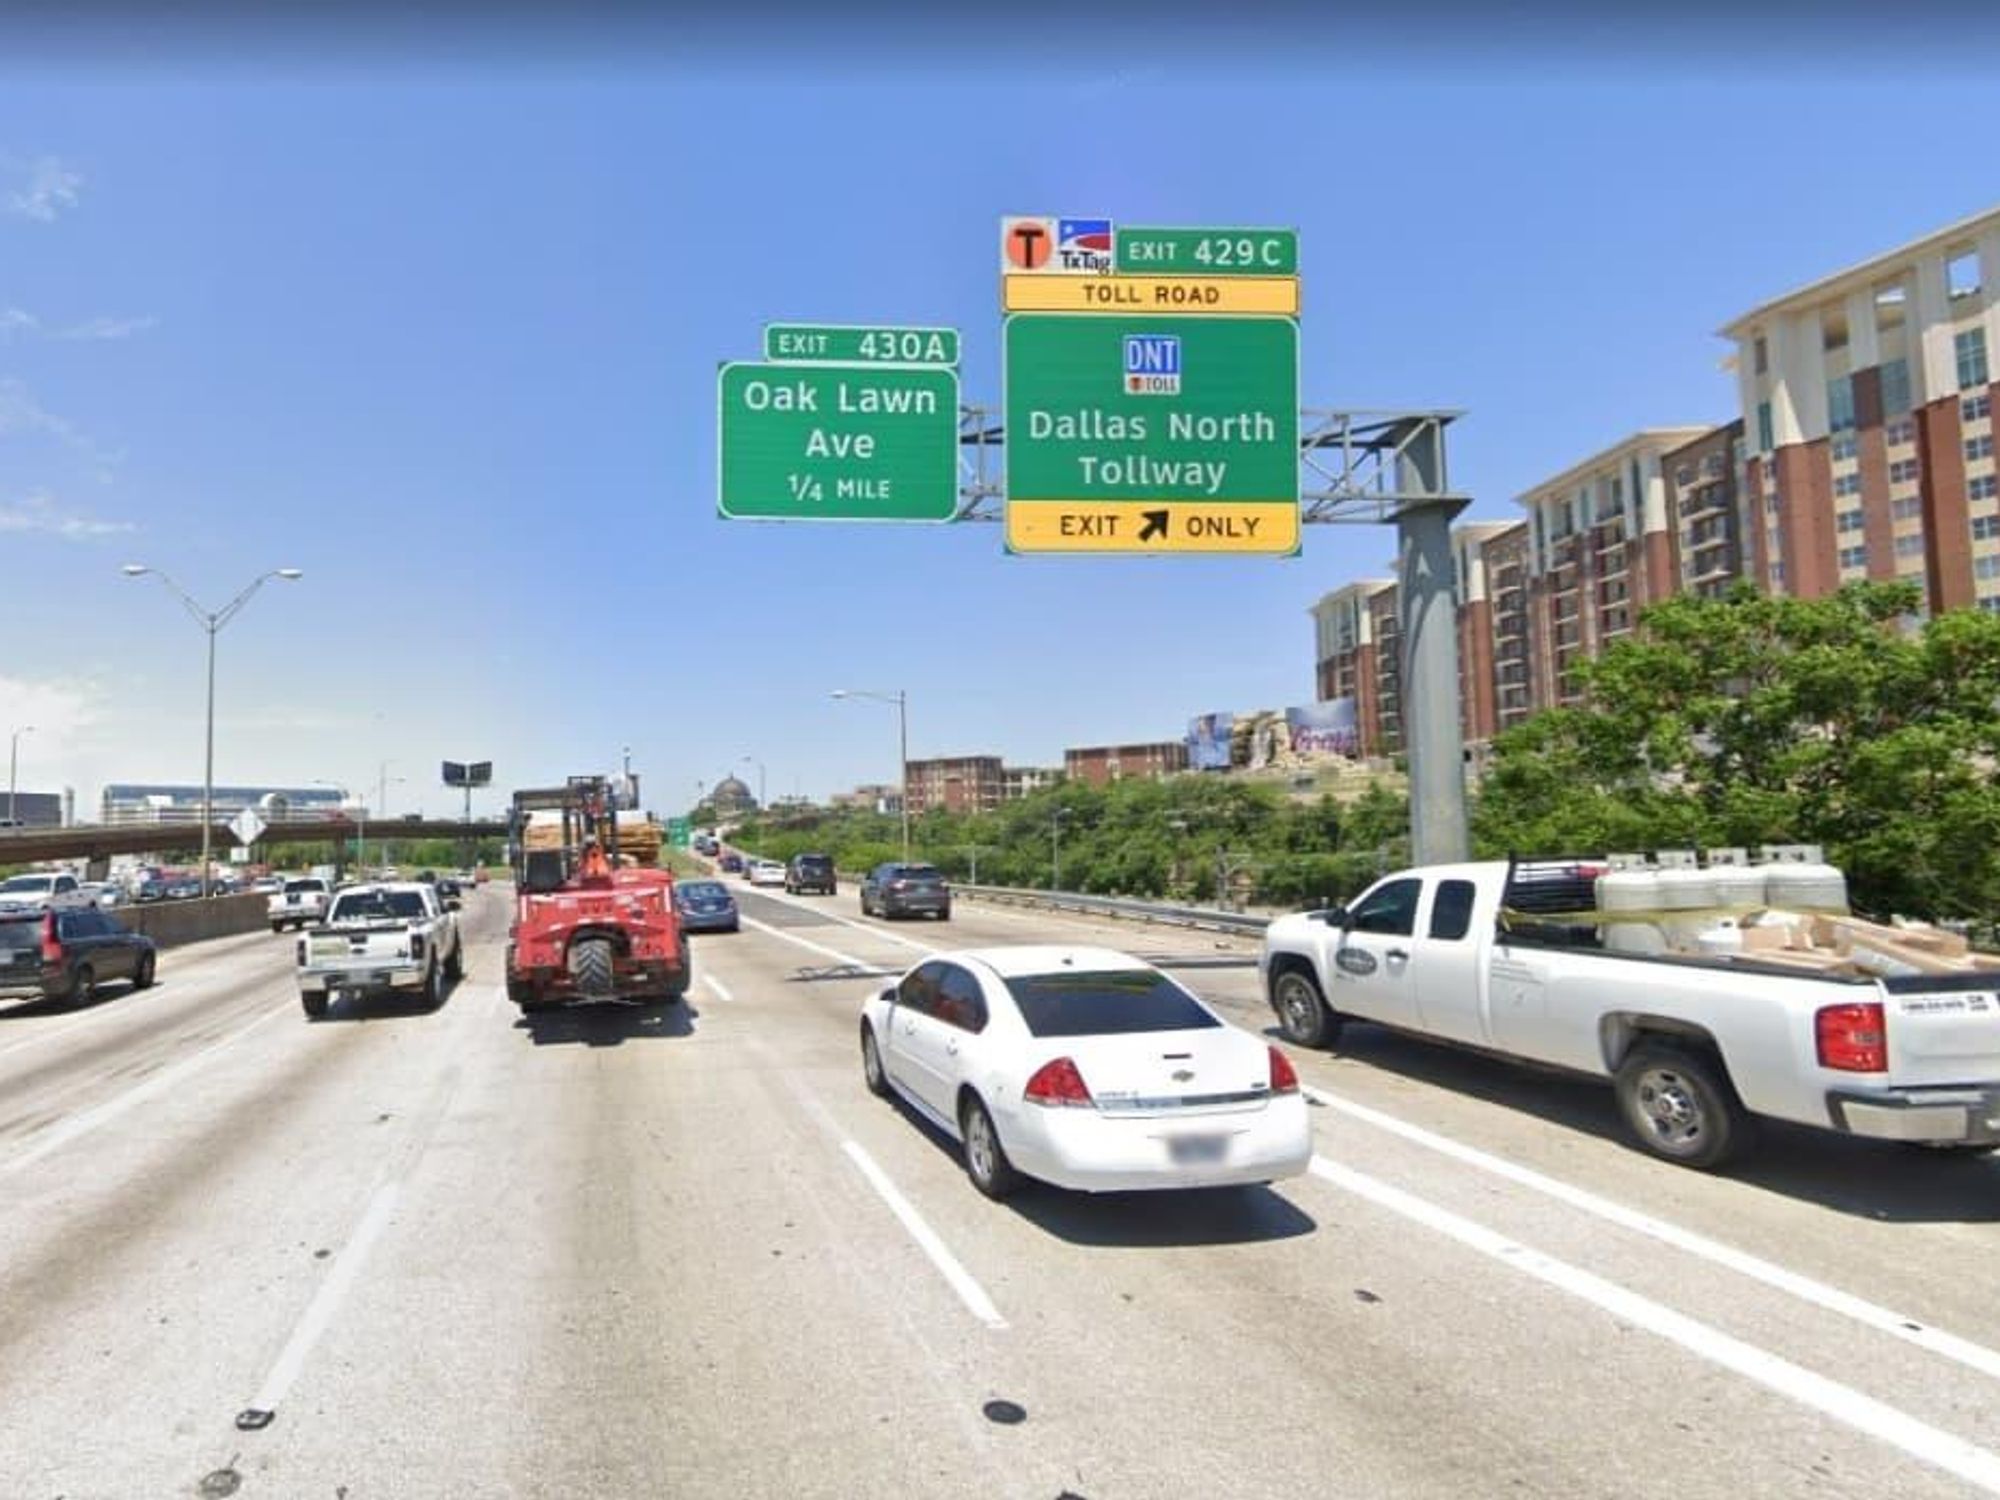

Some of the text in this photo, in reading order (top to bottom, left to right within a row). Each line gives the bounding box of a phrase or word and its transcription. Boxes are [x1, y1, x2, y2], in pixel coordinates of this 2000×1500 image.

[1060, 250, 1111, 275] TxTag
[1129, 241, 1177, 260] EXIT
[1083, 285, 1220, 304] TOLL ROAD
[778, 333, 946, 360] EXIT 430A
[1129, 340, 1176, 370] DNT
[1146, 377, 1176, 391] TOLL
[743, 381, 936, 414] Oak Lawn
[1029, 409, 1275, 441] Dallas North
[805, 428, 875, 458] Ave
[1078, 455, 1227, 494] Tollway
[836, 478, 891, 499] MILE
[1060, 514, 1261, 538] EXIT ONLY
